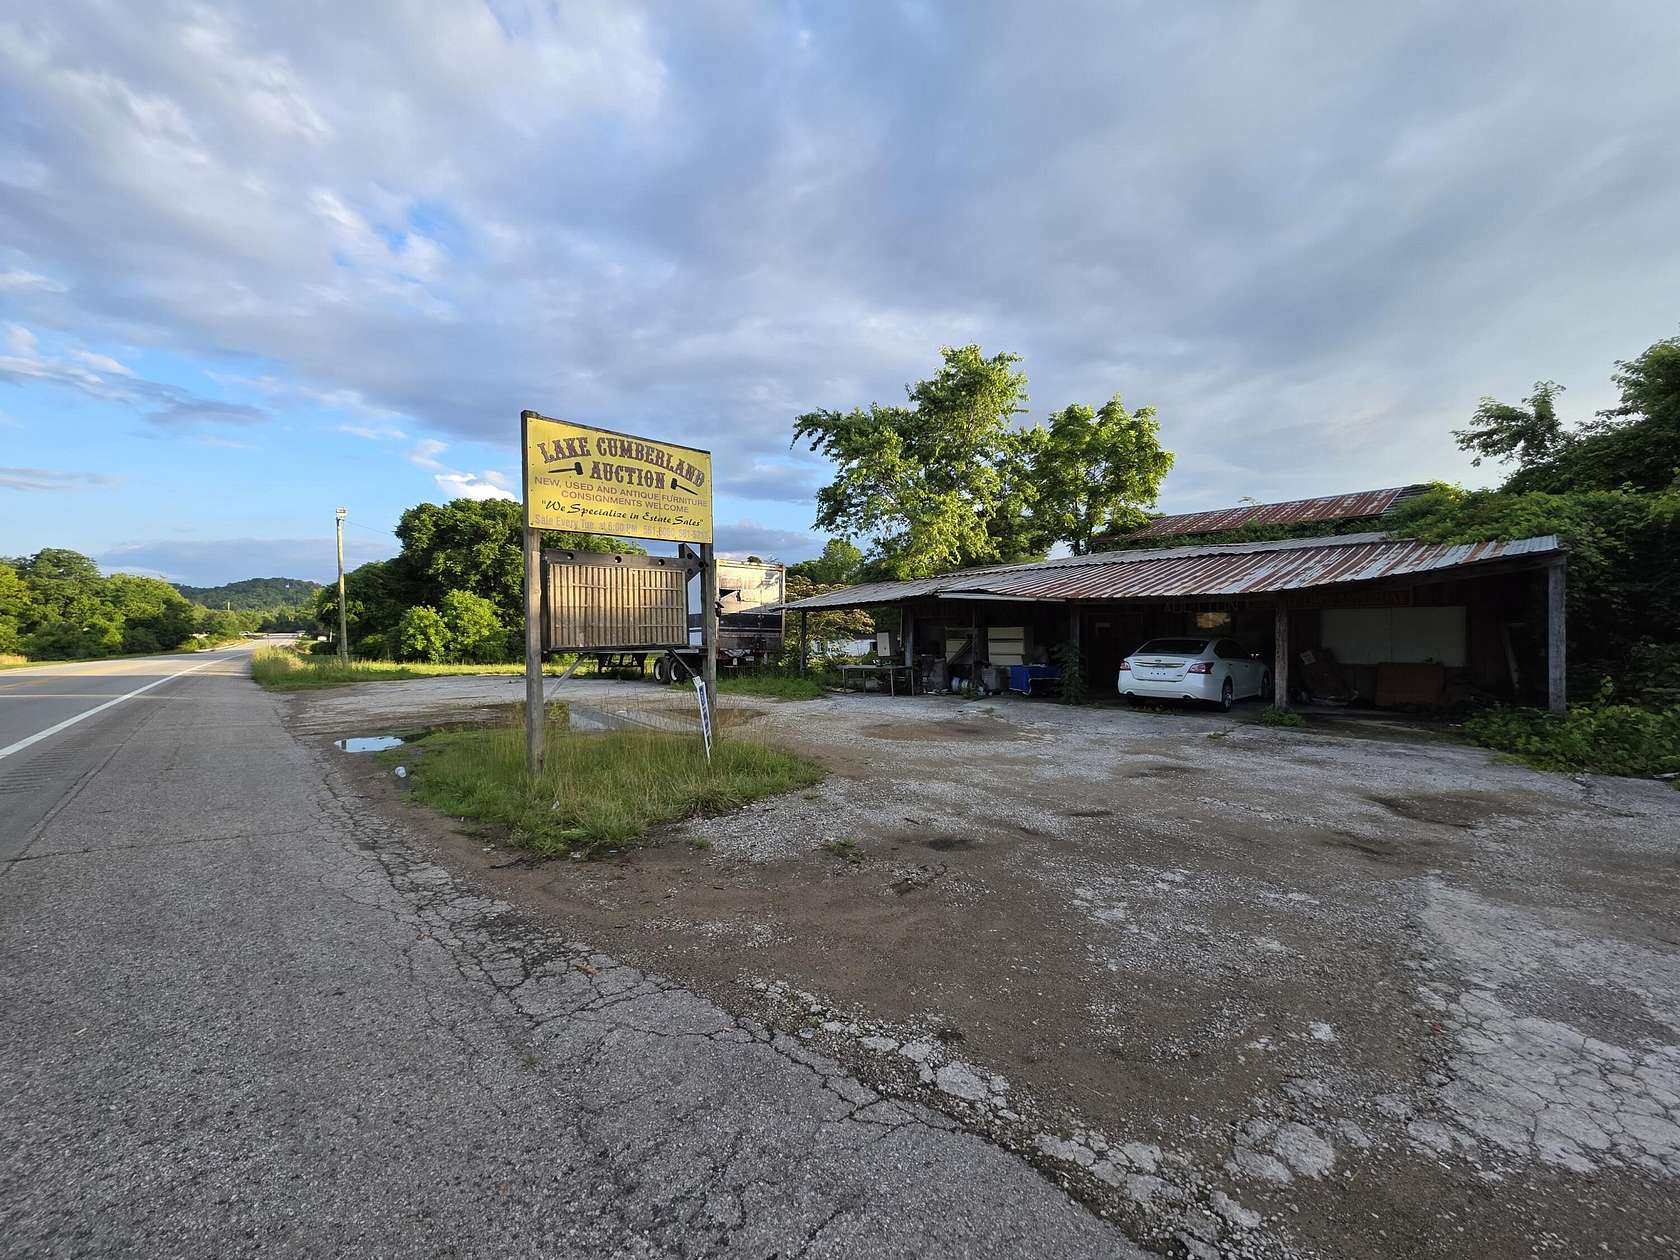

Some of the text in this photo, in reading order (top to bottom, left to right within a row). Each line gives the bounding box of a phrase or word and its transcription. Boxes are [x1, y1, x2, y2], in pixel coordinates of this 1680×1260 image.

[537, 436, 705, 488] LAKE CUMBERLAND
[590, 461, 666, 489] AUCTION
[534, 476, 707, 507] NEW, USED AND ANTIQUE FURNITURE
[561, 490, 689, 513] CONSIGNMENTS WELCOME
[535, 514, 553, 526] Sale
[556, 516, 577, 529] Every
[567, 503, 627, 519] Specialize
[629, 511, 639, 520] in
[642, 512, 671, 523] Estate
